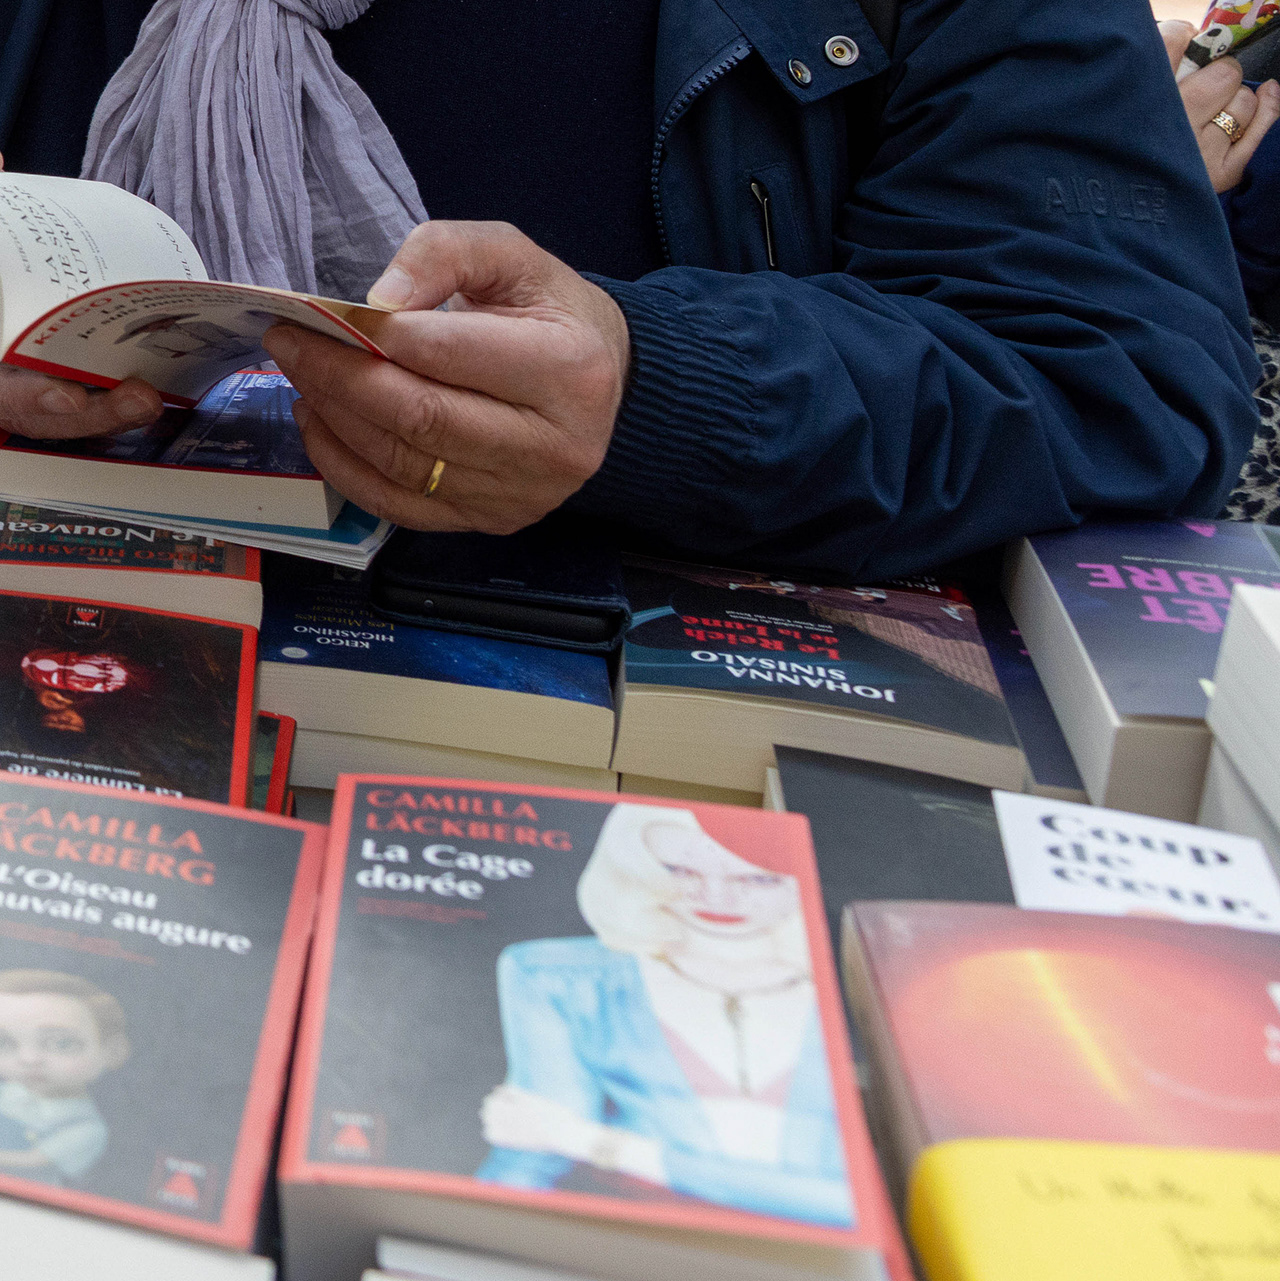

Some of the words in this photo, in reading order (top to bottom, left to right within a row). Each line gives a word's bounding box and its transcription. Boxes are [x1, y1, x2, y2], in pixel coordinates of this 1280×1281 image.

[134, 547, 218, 566] KEIGO
[293, 624, 396, 643] HIGASHINO
[294, 611, 365, 628] Miracles
[368, 619, 396, 631] Les
[679, 612, 772, 640] Lune
[780, 626, 811, 642] la
[316, 634, 370, 650] KEIGO
[683, 626, 787, 656] Reich
[798, 639, 842, 661] Le
[815, 629, 840, 646] de
[690, 648, 848, 686] SINISALO
[724, 665, 896, 704] JOHANNA
[365, 788, 540, 825] CAMILLA
[362, 809, 574, 853] LÄCKBERG
[1039, 812, 1231, 867] Coup
[359, 836, 414, 866] La
[421, 842, 536, 882] Cage
[1046, 842, 1134, 868] de
[355, 864, 485, 901] dorée
[1051, 866, 1274, 921] cœur.
[109, 904, 255, 958] augure
